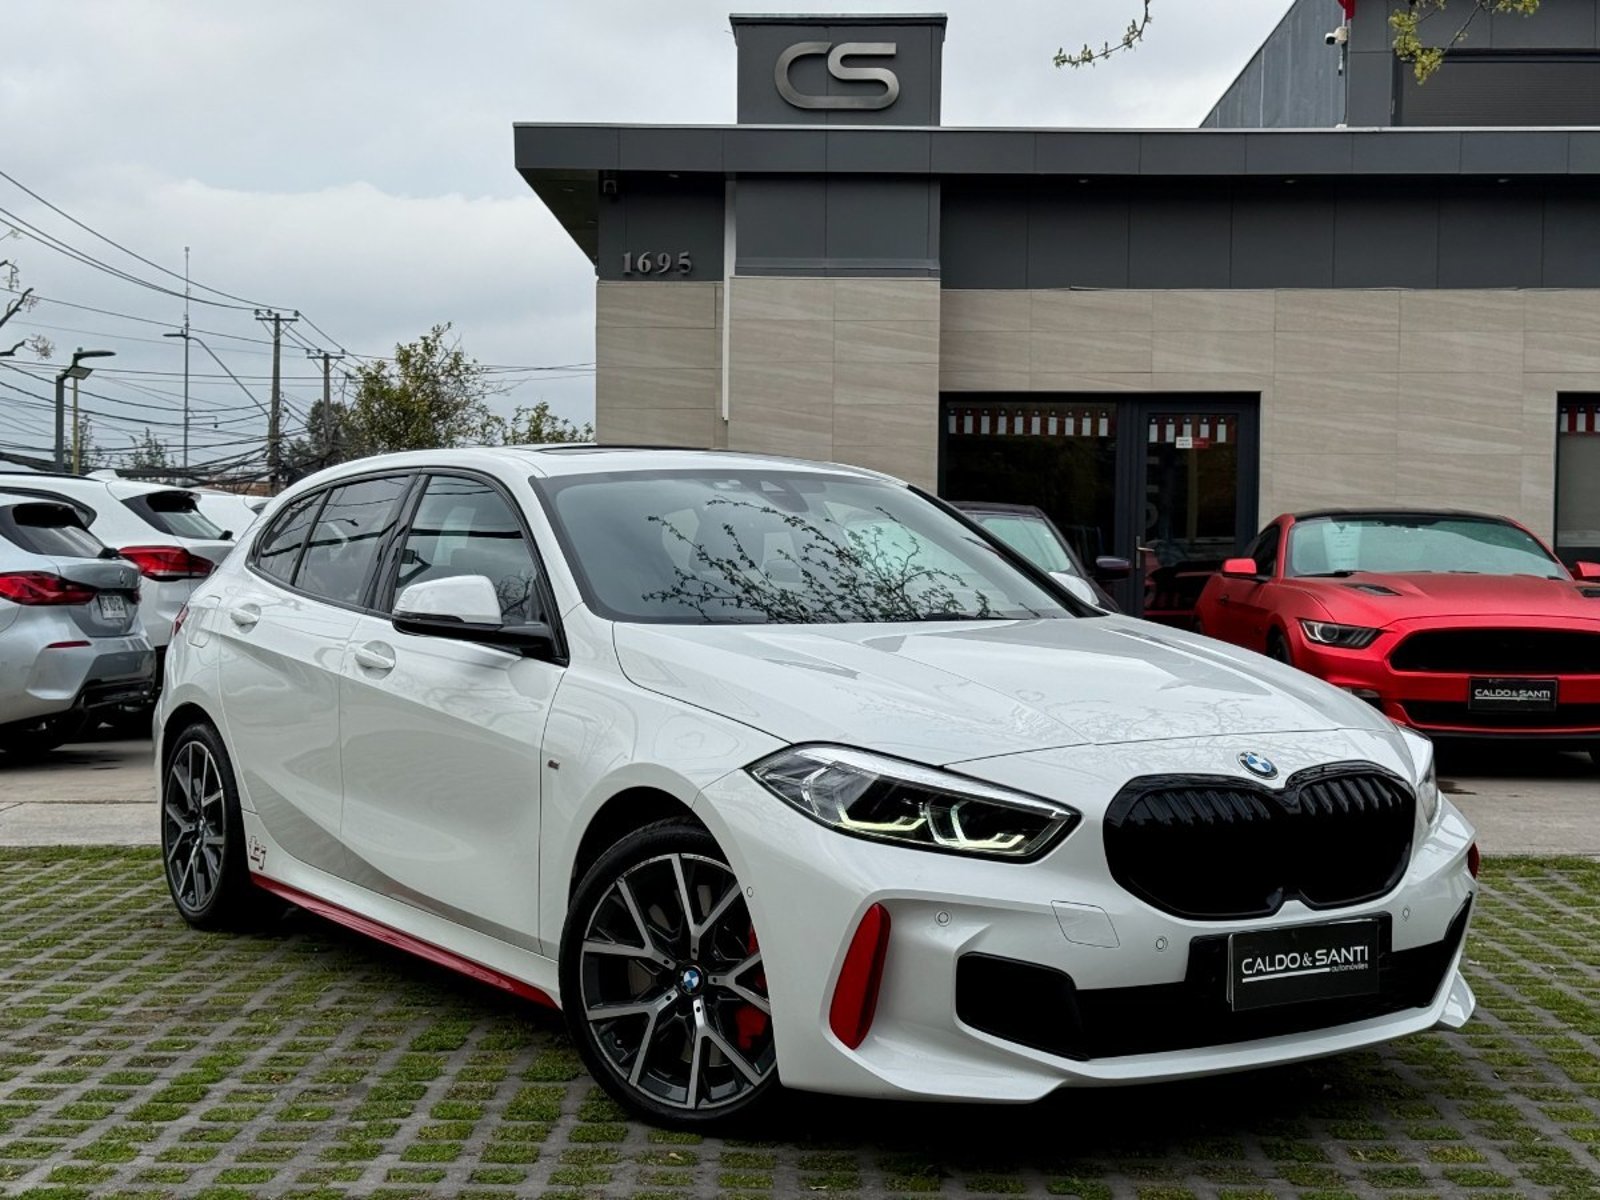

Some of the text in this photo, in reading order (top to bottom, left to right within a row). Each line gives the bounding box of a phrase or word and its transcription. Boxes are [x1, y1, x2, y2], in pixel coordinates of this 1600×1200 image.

[775, 41, 900, 110] CS
[622, 251, 692, 273] 1695
[1241, 953, 1300, 975] CALDO
[1315, 945, 1368, 966] SANTI
